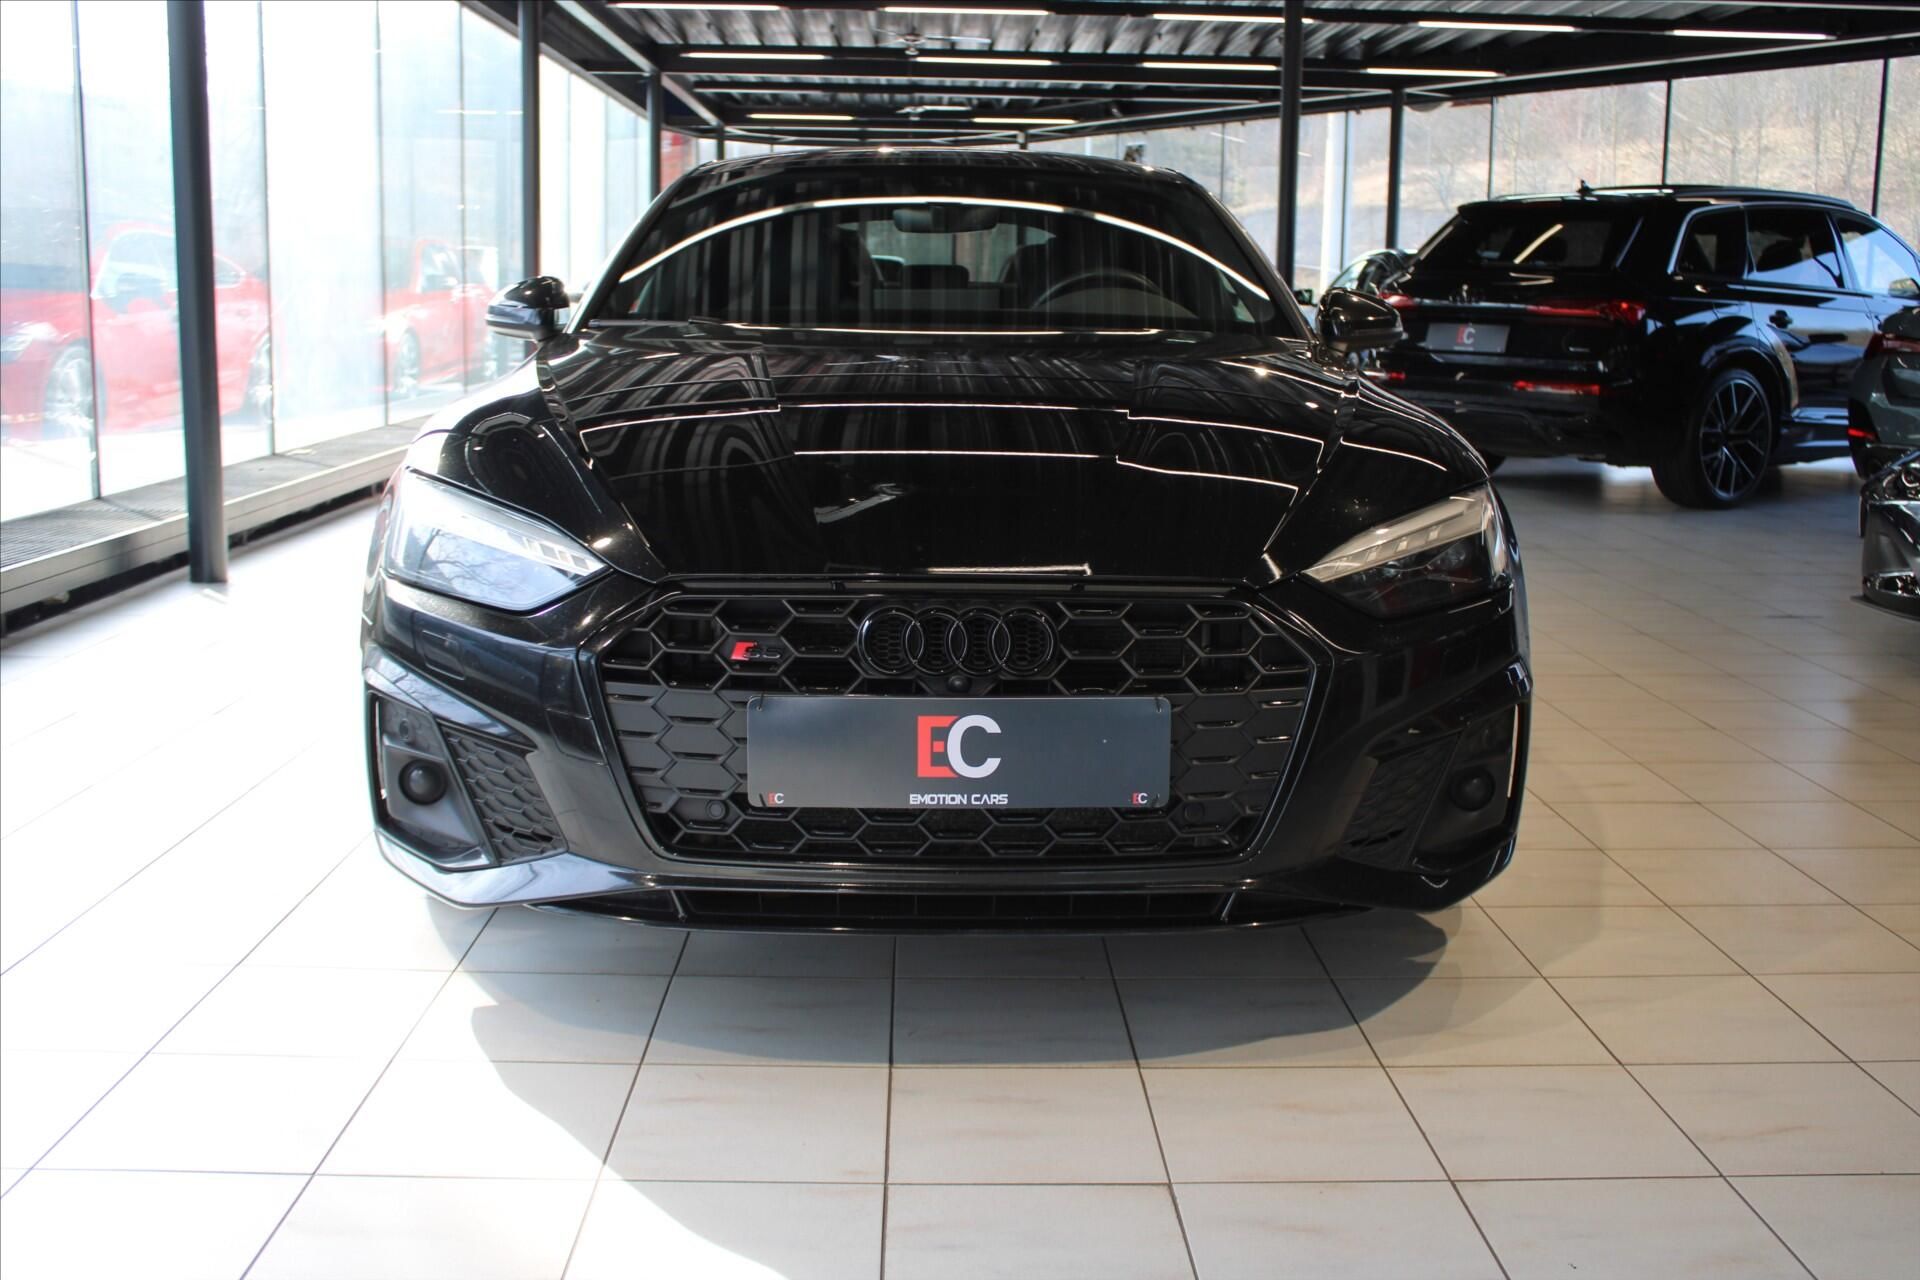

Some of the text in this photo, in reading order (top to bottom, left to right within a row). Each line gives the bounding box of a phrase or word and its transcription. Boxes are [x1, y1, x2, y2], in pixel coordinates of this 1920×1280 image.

[916, 714, 1002, 778] EC
[909, 793, 1009, 805] EMOTION CARS
